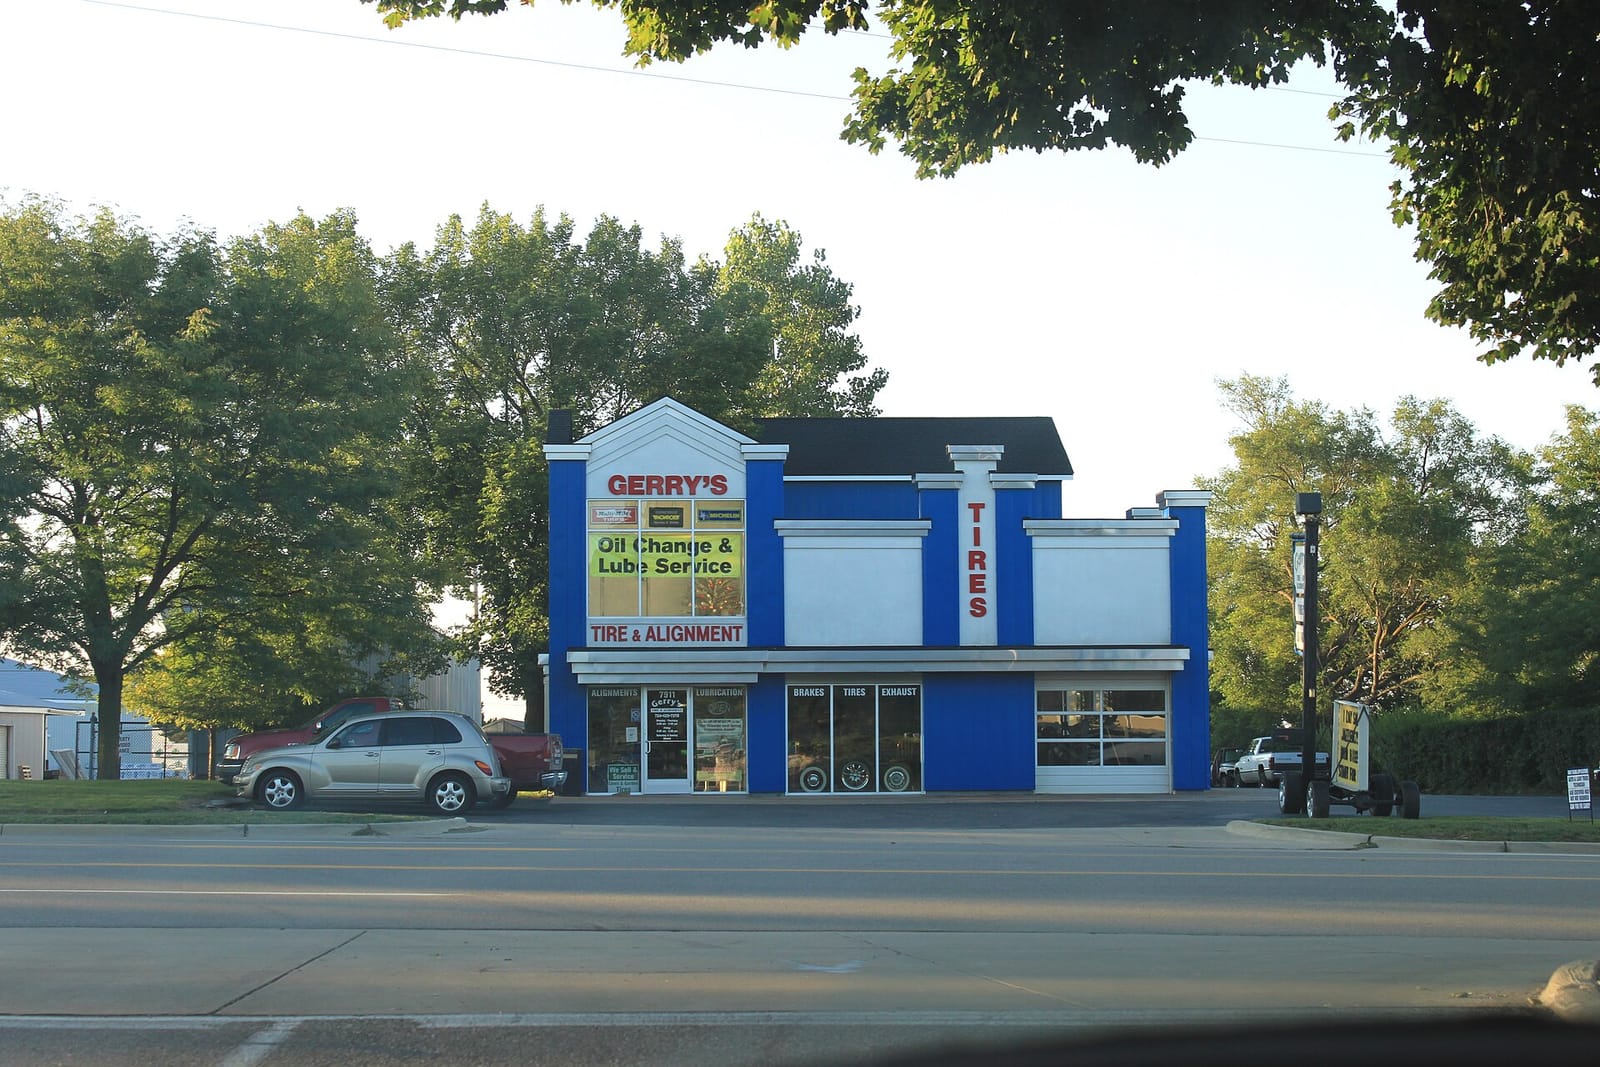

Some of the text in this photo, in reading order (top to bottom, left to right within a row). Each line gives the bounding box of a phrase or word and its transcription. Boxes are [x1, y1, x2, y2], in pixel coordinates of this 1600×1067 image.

[608, 475, 728, 495] GERRY'S
[598, 537, 733, 556] Oil Change &
[968, 503, 987, 618] TIRES
[599, 558, 732, 573] Lube Service
[591, 626, 743, 642] TIRE & ALIGNMENT
[591, 688, 638, 697] ALIGNMENTS
[696, 688, 743, 696] LUBRICATION
[793, 688, 825, 697] BRAKES
[843, 688, 866, 696] TIRES
[881, 687, 917, 696] EXHAUST
[651, 699, 682, 708] Gerry's
